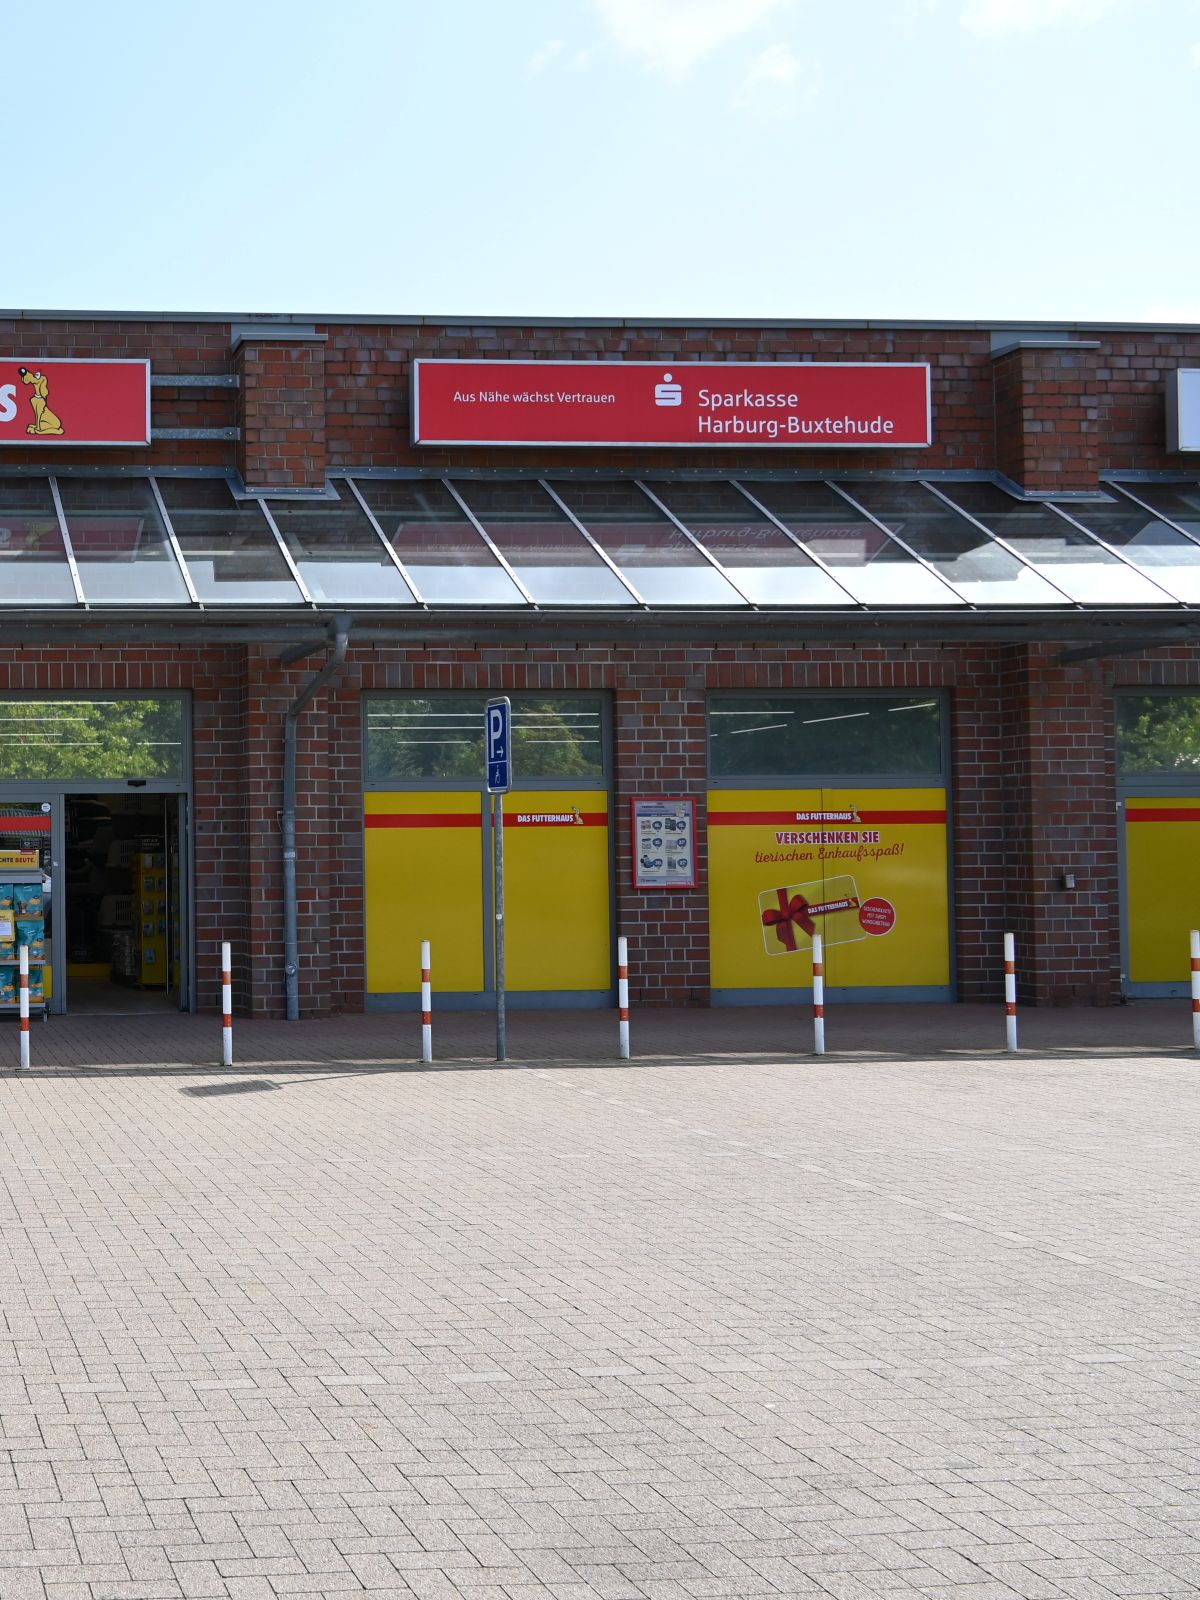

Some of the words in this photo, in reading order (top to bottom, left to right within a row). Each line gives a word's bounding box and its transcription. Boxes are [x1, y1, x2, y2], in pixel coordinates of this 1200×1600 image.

[453, 391, 476, 403] Aus
[479, 391, 510, 403] Nähe
[512, 391, 554, 403] wächst
[557, 391, 615, 403] Vertrauen
[698, 389, 799, 411] Sparkasse
[698, 416, 894, 438] Harburg-Buxtehude
[489, 709, 503, 758] P
[517, 814, 531, 822] DAS
[532, 814, 574, 822] FUTTERHAUS
[796, 812, 810, 821] DAS
[811, 812, 852, 820] FUTTERHAUS
[775, 831, 859, 844] VERSCHENKEN
[862, 831, 879, 843] SIE
[755, 849, 814, 863] tierischen
[818, 843, 905, 862] Einkaufsspaß!
